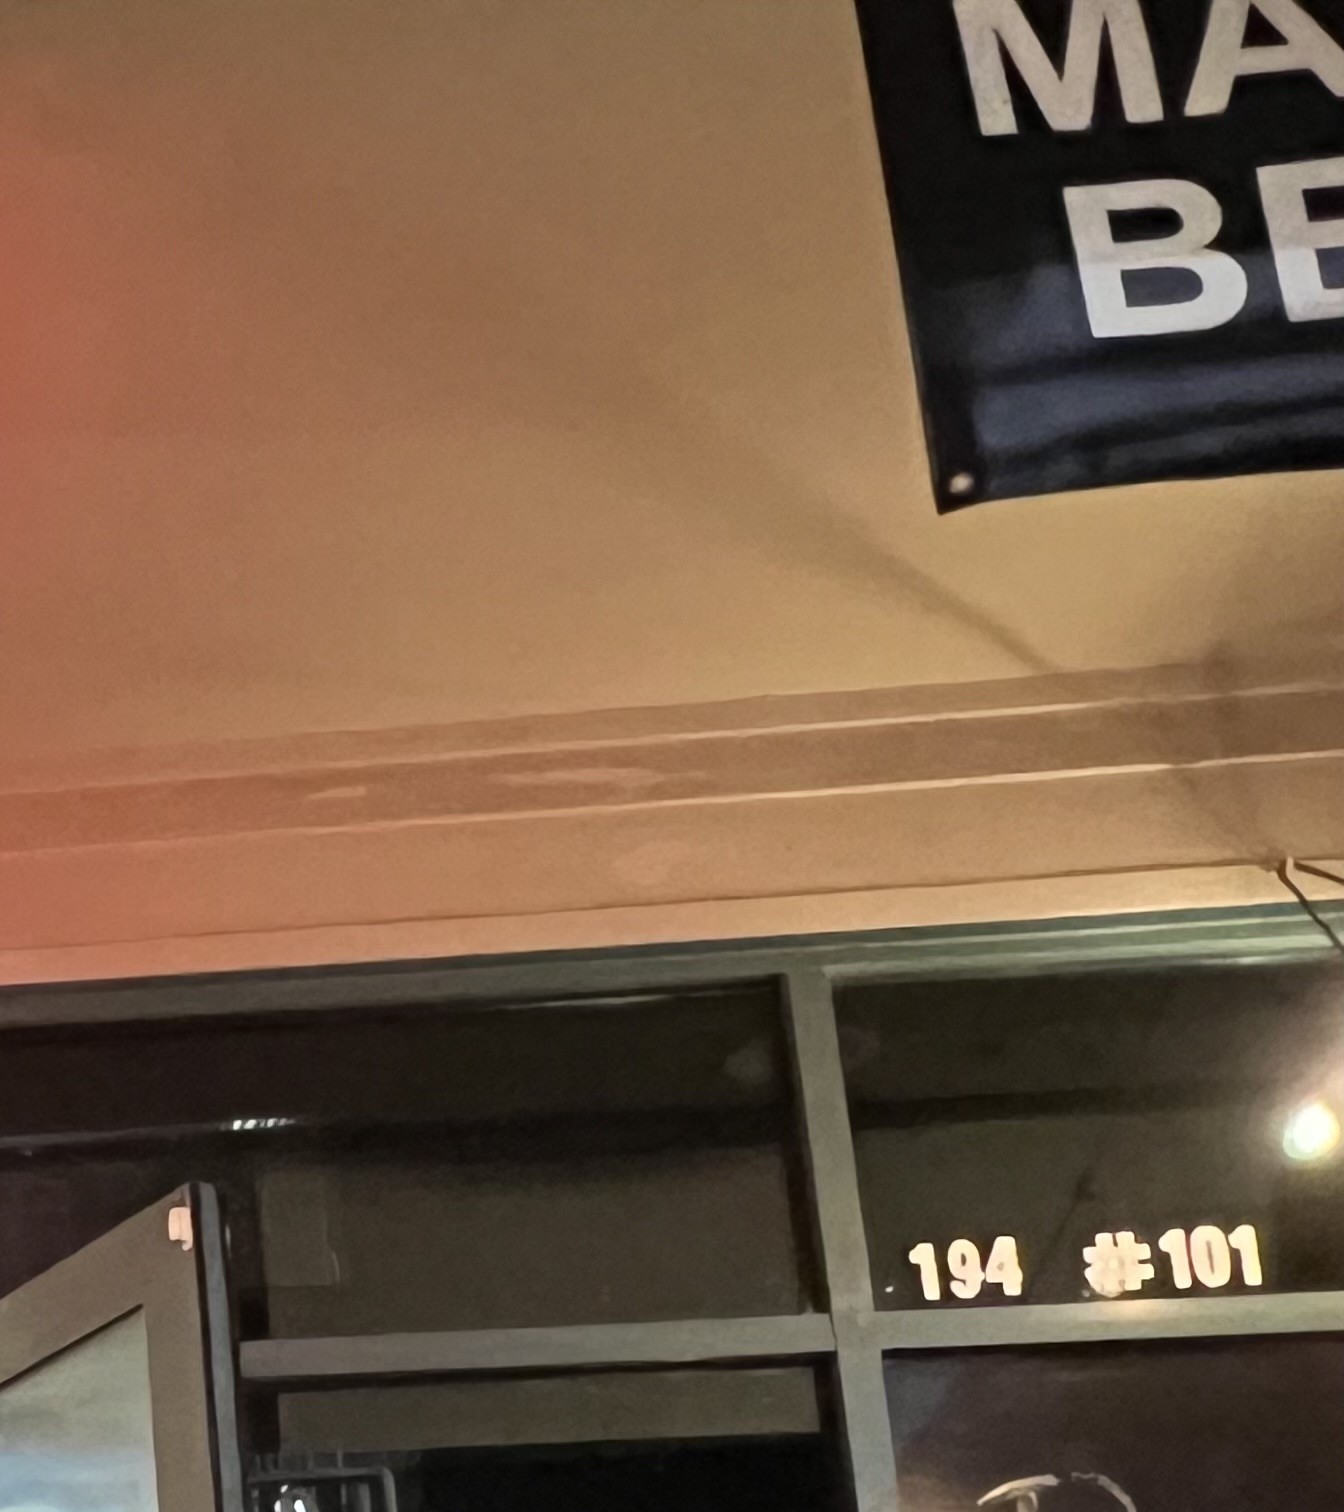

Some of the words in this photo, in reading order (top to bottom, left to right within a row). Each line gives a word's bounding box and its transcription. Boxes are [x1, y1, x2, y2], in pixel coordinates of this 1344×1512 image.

[951, 0, 1344, 136] MA
[908, 1235, 1024, 1301] 194
[1082, 1224, 1264, 1298] #101
